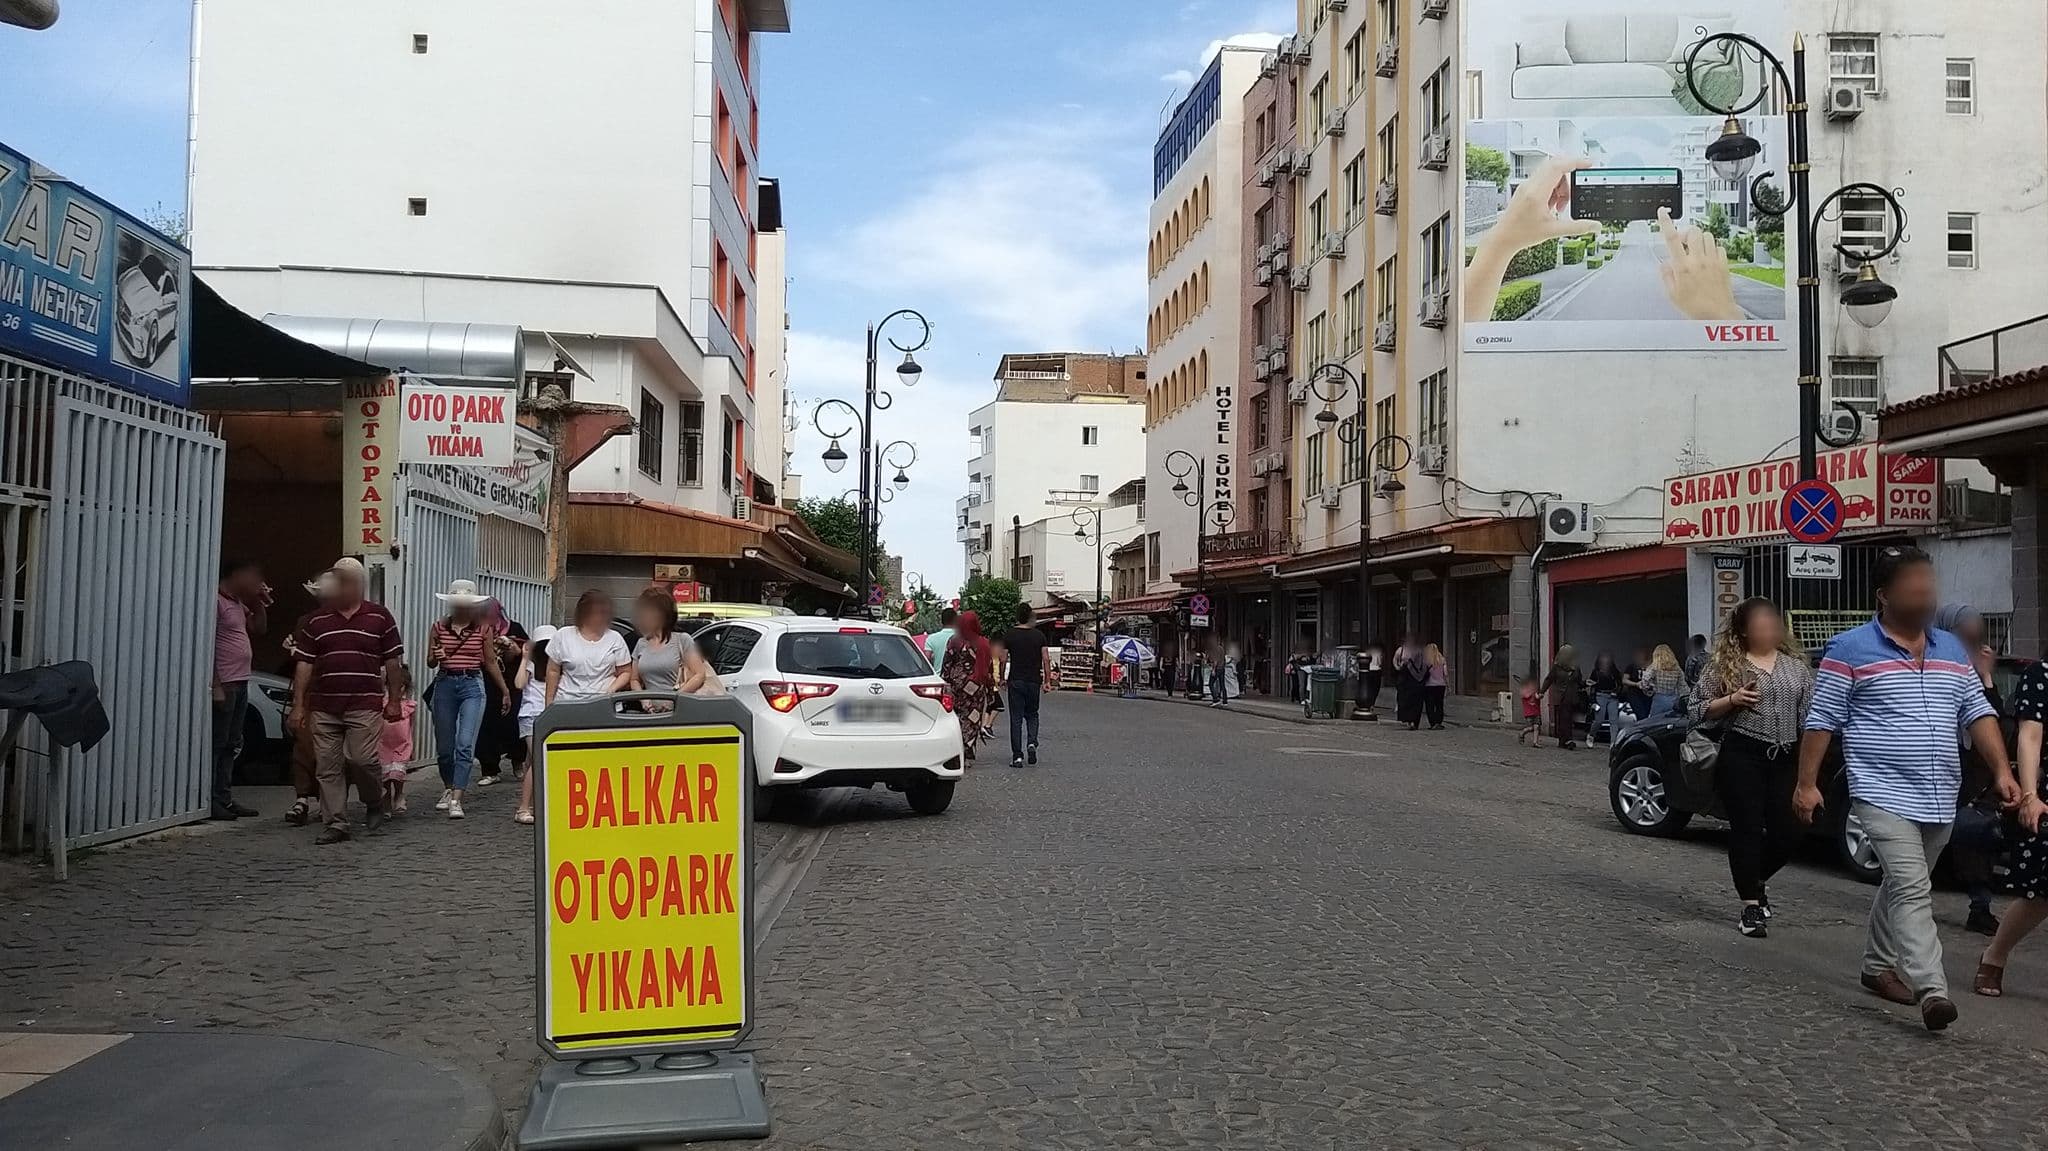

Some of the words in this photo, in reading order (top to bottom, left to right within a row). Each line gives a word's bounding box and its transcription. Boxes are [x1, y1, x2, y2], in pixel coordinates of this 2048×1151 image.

[31, 273, 102, 335] MERKEZİ
[2, 314, 21, 331] 36
[1705, 326, 1779, 342] VESTEL
[346, 379, 396, 399] BALKAR
[408, 393, 447, 421] OTO
[452, 395, 506, 423] PARK
[1215, 386, 1232, 444] HOTEL
[450, 424, 462, 434] ve
[427, 435, 484, 458] YIKAMA
[1670, 471, 1740, 507] SARAY
[1748, 447, 1869, 495] OTOARK
[1889, 488, 1932, 504] OTO
[1701, 505, 1740, 537] OTO
[1890, 507, 1931, 520] PARK
[568, 763, 719, 830] BALKAR
[554, 853, 735, 923] OTOPARK
[570, 945, 723, 1013] YIKAMA
